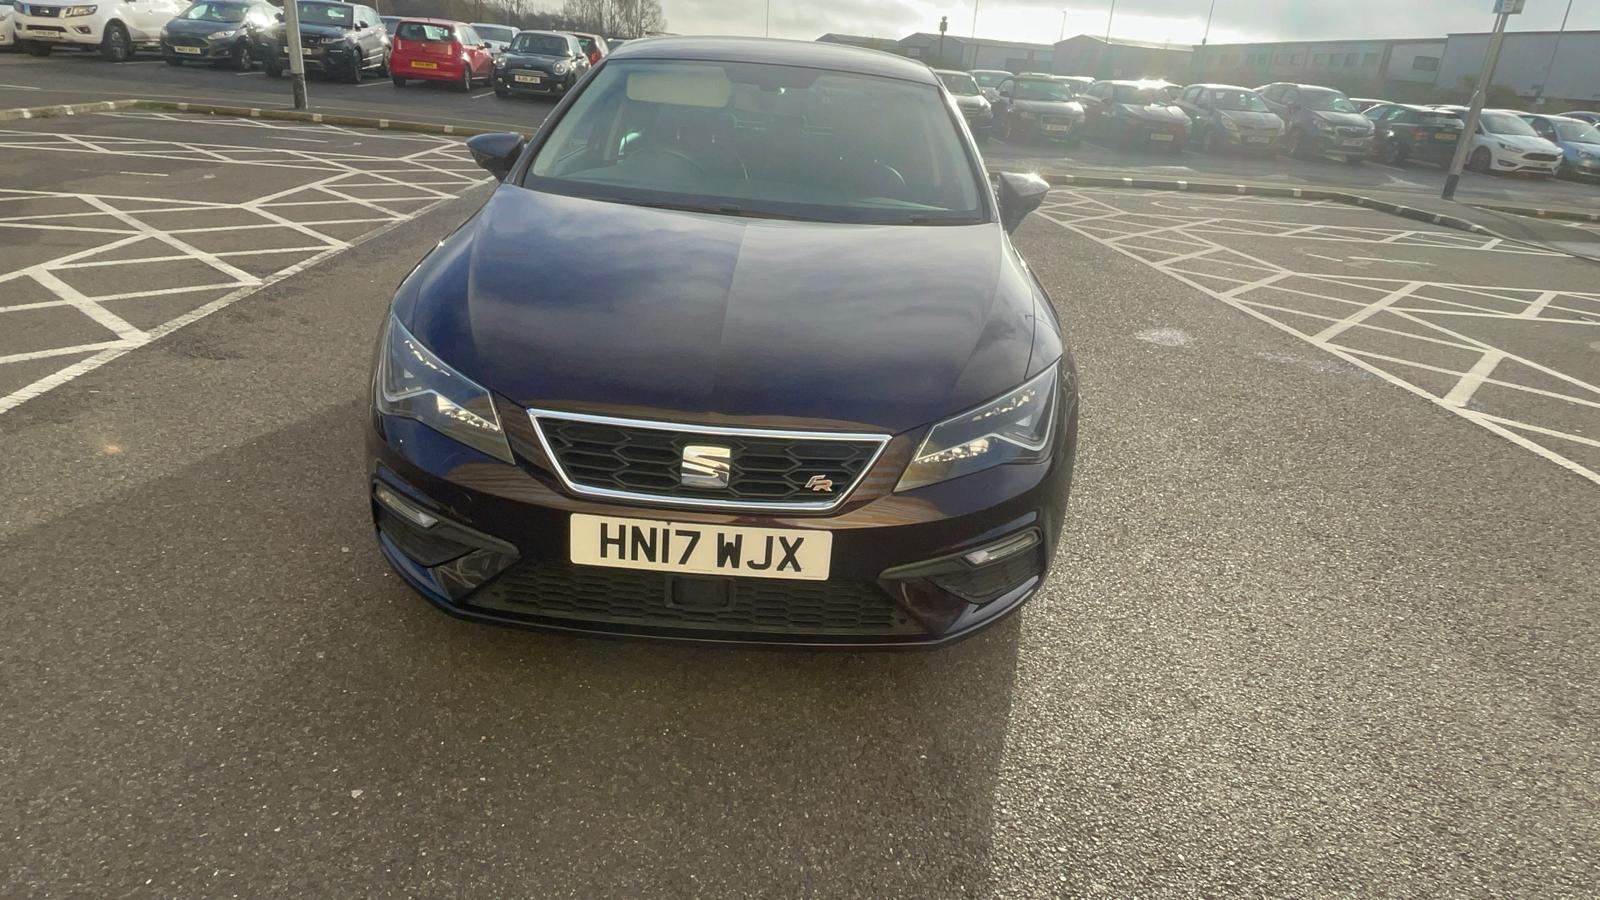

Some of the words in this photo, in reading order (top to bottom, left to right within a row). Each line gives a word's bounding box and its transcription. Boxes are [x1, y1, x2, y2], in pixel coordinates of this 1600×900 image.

[805, 474, 833, 492] FR
[600, 522, 701, 565] HN17
[716, 532, 805, 573] WJX
